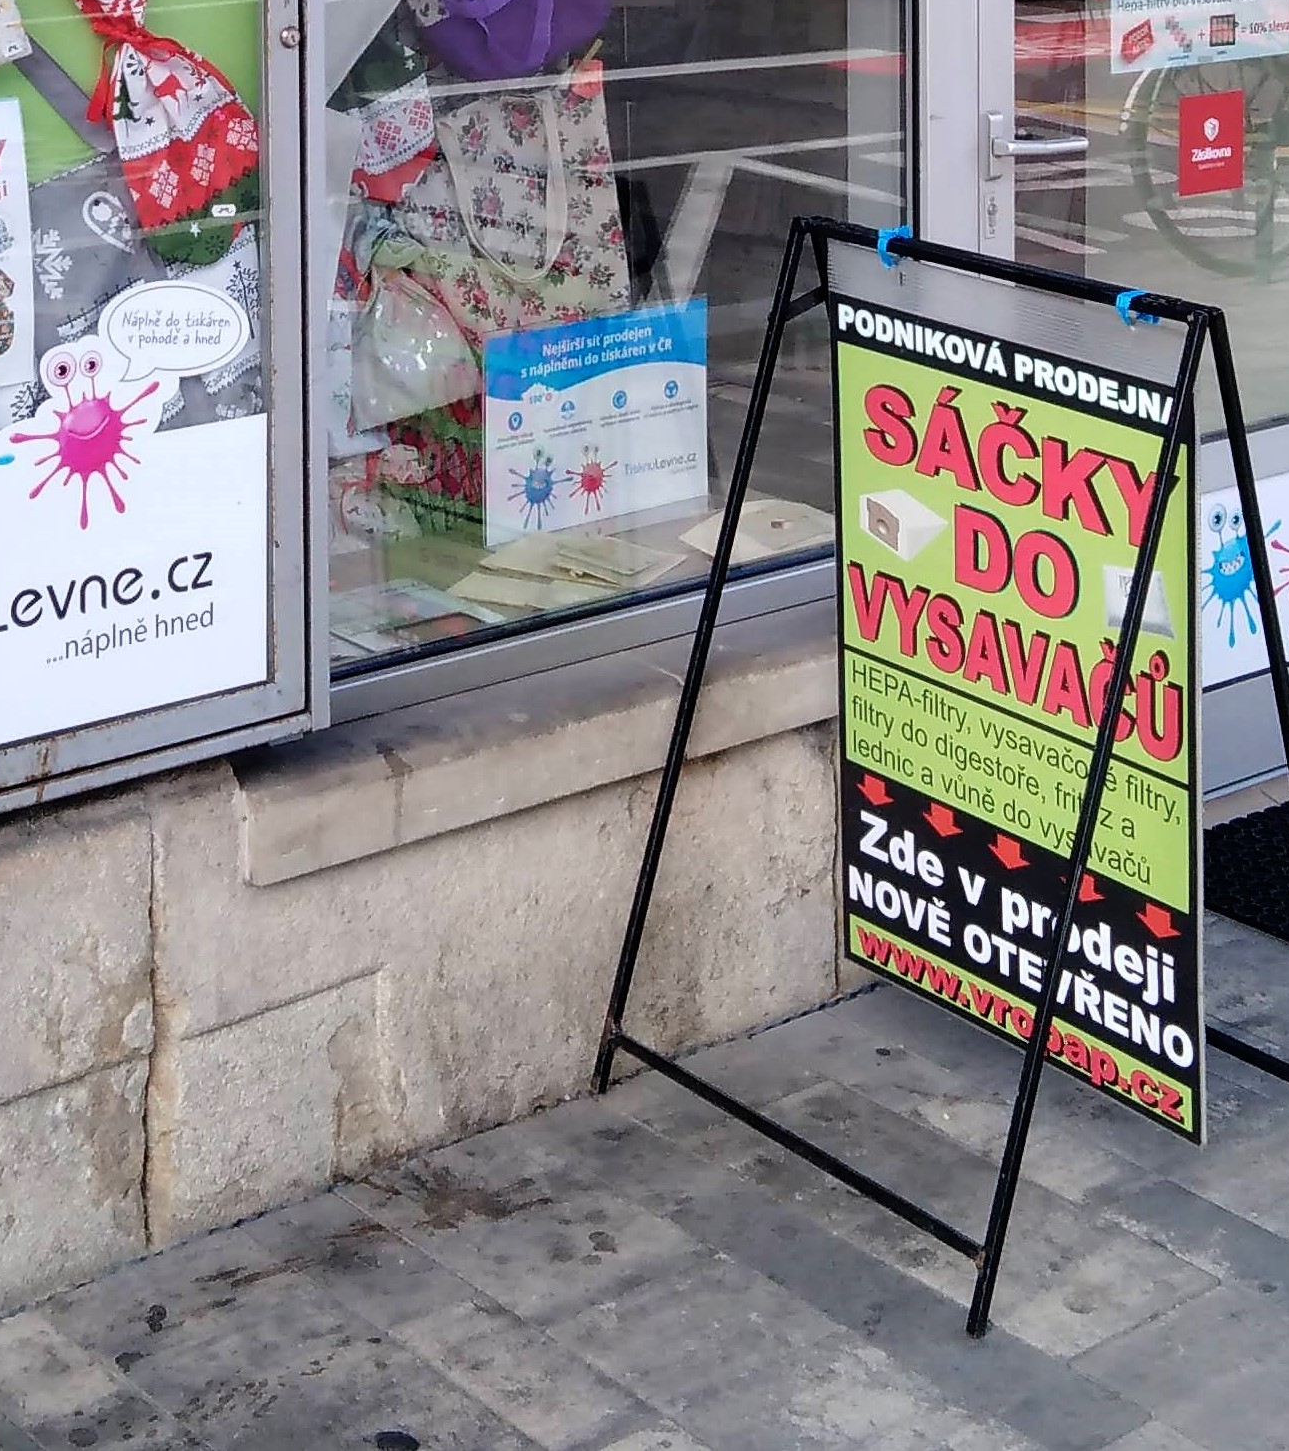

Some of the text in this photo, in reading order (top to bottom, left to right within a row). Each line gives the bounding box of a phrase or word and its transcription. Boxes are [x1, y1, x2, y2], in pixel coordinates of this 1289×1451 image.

[122, 309, 231, 331] Náplně do tiskáren
[128, 327, 222, 349] v pohodě a hned
[521, 367, 528, 379] s
[584, 351, 599, 365] do
[601, 345, 647, 363] tiskáren
[648, 343, 655, 354] v
[657, 337, 672, 352] ČR
[603, 325, 652, 349] prodejen
[837, 302, 1009, 378] PODNIKOVÁ
[863, 385, 1178, 549] SÁČKY
[953, 503, 1079, 620] DO
[154, 601, 215, 640] hned
[848, 561, 1184, 763] VYSAVAČŮ
[851, 695, 1136, 840] filtry do digestoře, fritz a
[852, 659, 1182, 826] HEPA-filtry, vysavačoé filtry,
[852, 729, 1152, 886] lednic a vůně do vysvačů
[859, 809, 946, 888] Zde
[957, 864, 987, 907] v
[848, 863, 952, 948] NOVĚ
